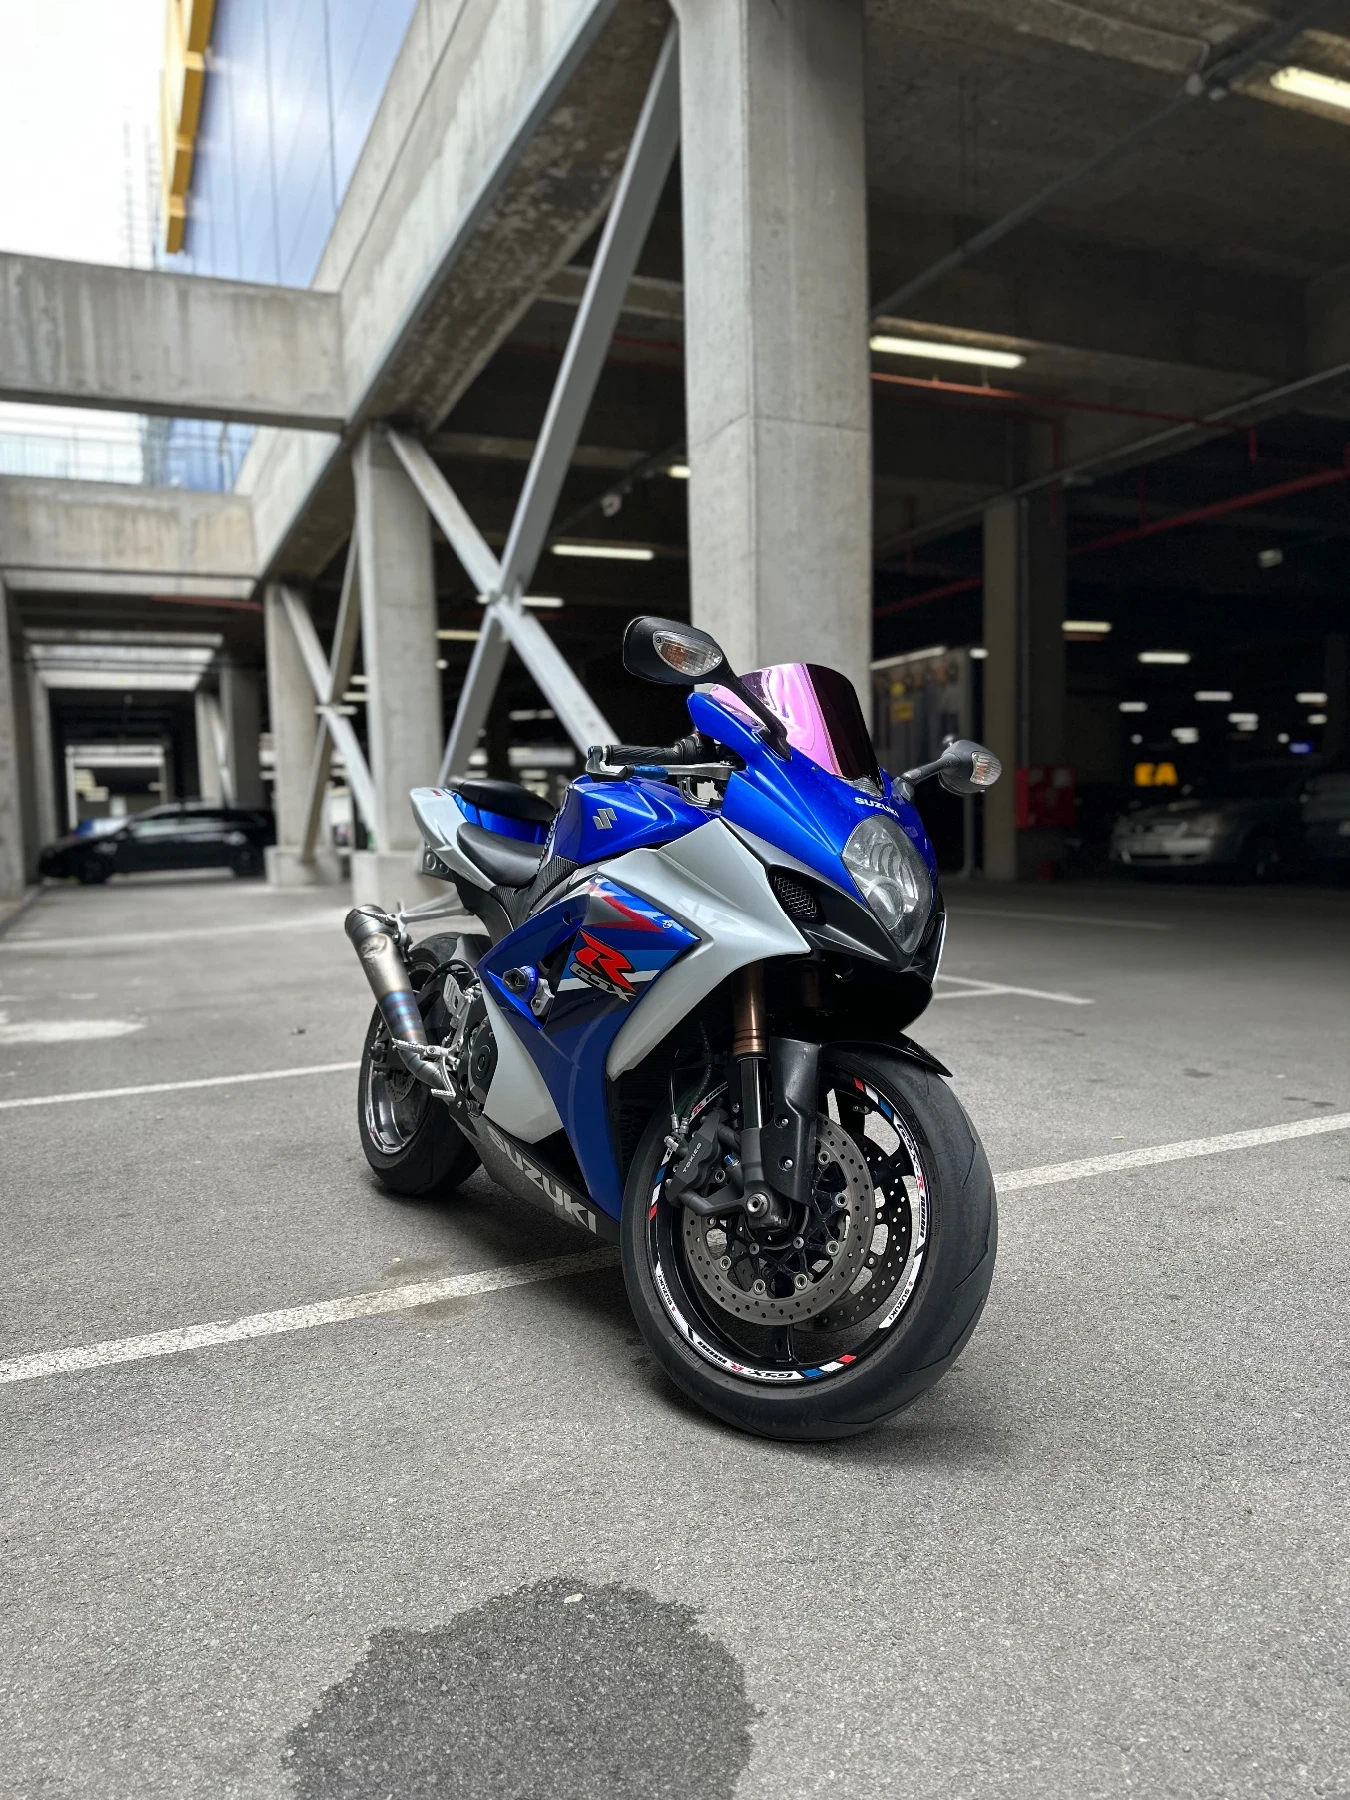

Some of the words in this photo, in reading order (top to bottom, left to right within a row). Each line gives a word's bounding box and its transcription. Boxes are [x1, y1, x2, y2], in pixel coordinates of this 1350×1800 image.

[854, 797, 900, 818] SUZUKI
[569, 962, 637, 1003] GSX
[487, 1125, 597, 1235] SUZUKI
[889, 1288, 910, 1321] SUZUKI
